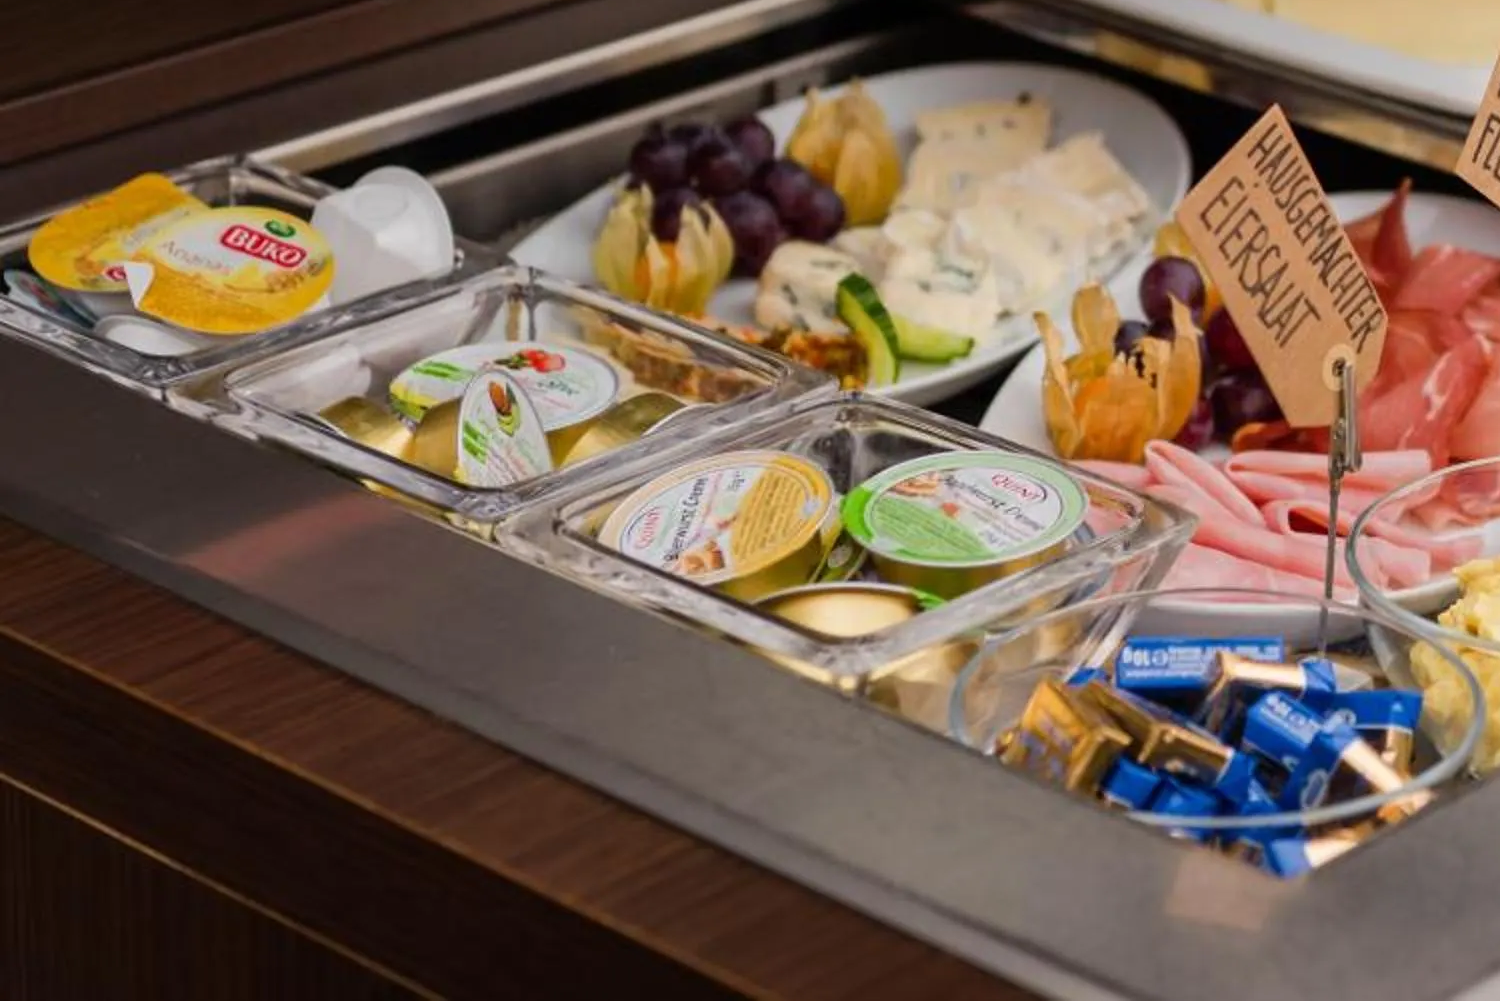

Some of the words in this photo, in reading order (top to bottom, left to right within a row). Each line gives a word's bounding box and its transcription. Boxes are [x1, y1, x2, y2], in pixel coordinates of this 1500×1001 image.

[223, 226, 302, 265] BUKO
[1199, 175, 1322, 348] EIERSALAT
[1247, 123, 1384, 354] HAUSGEMACHTER
